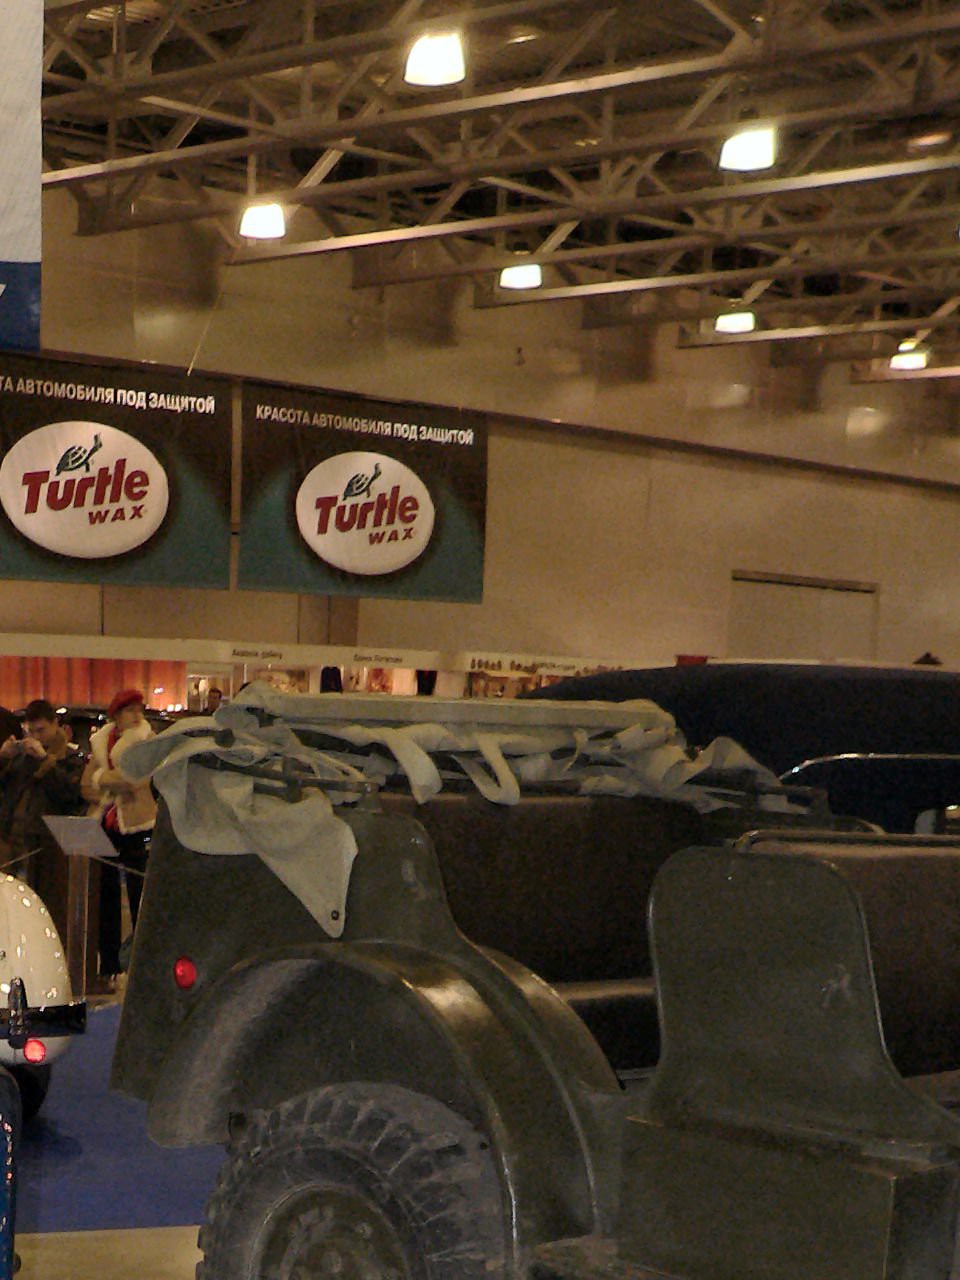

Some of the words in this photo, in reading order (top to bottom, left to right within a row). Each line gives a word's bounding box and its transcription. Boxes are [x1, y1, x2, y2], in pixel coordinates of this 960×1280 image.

[16, 378, 115, 404] АВТОМОБИЛЯ
[116, 389, 146, 410] ПОД
[148, 393, 216, 414] ЗАЩИТОЙ
[256, 404, 310, 424] КРАСОТА
[312, 412, 392, 435] АВТОМОБИЛЯ
[393, 422, 418, 441] ПОД
[419, 426, 474, 445] ЗАЩИТОЙ
[21, 458, 150, 514] Turtle
[88, 504, 145, 525] WAX
[315, 485, 420, 535] Turtle
[368, 527, 414, 545] WAX
